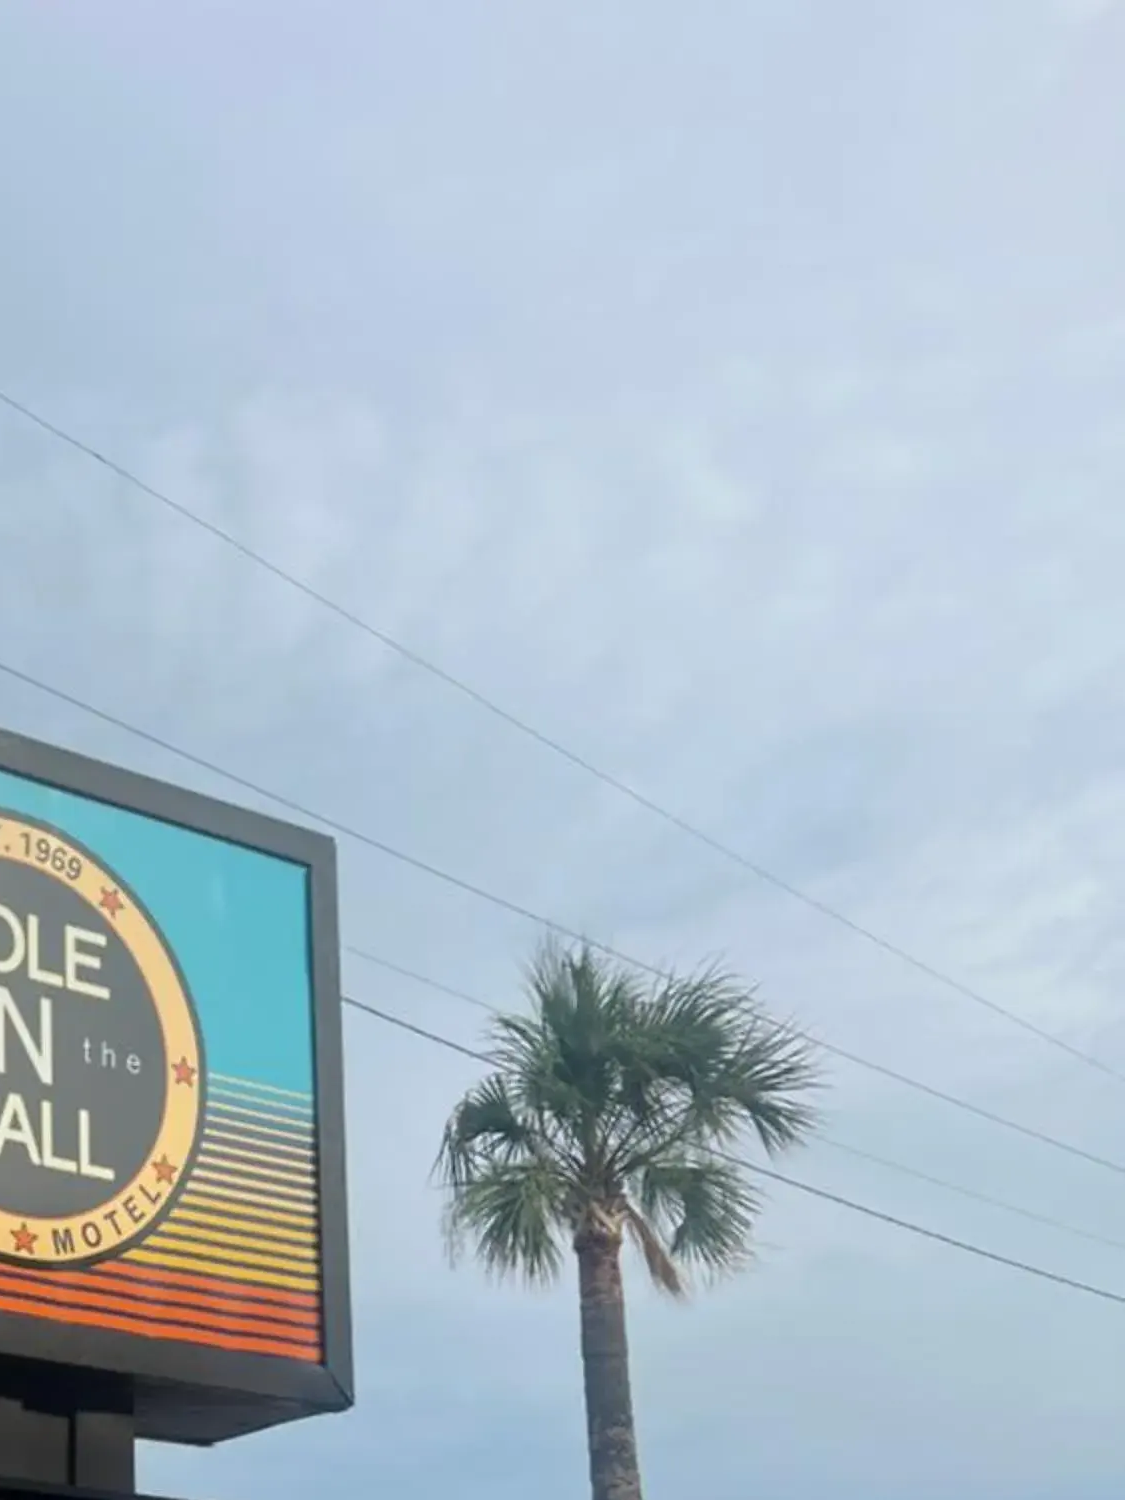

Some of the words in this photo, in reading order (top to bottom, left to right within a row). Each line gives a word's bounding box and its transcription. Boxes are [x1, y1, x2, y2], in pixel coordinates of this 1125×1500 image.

[20, 831, 83, 881] 1969
[81, 1036, 142, 1075] the
[52, 1184, 162, 1256] MOTEL
